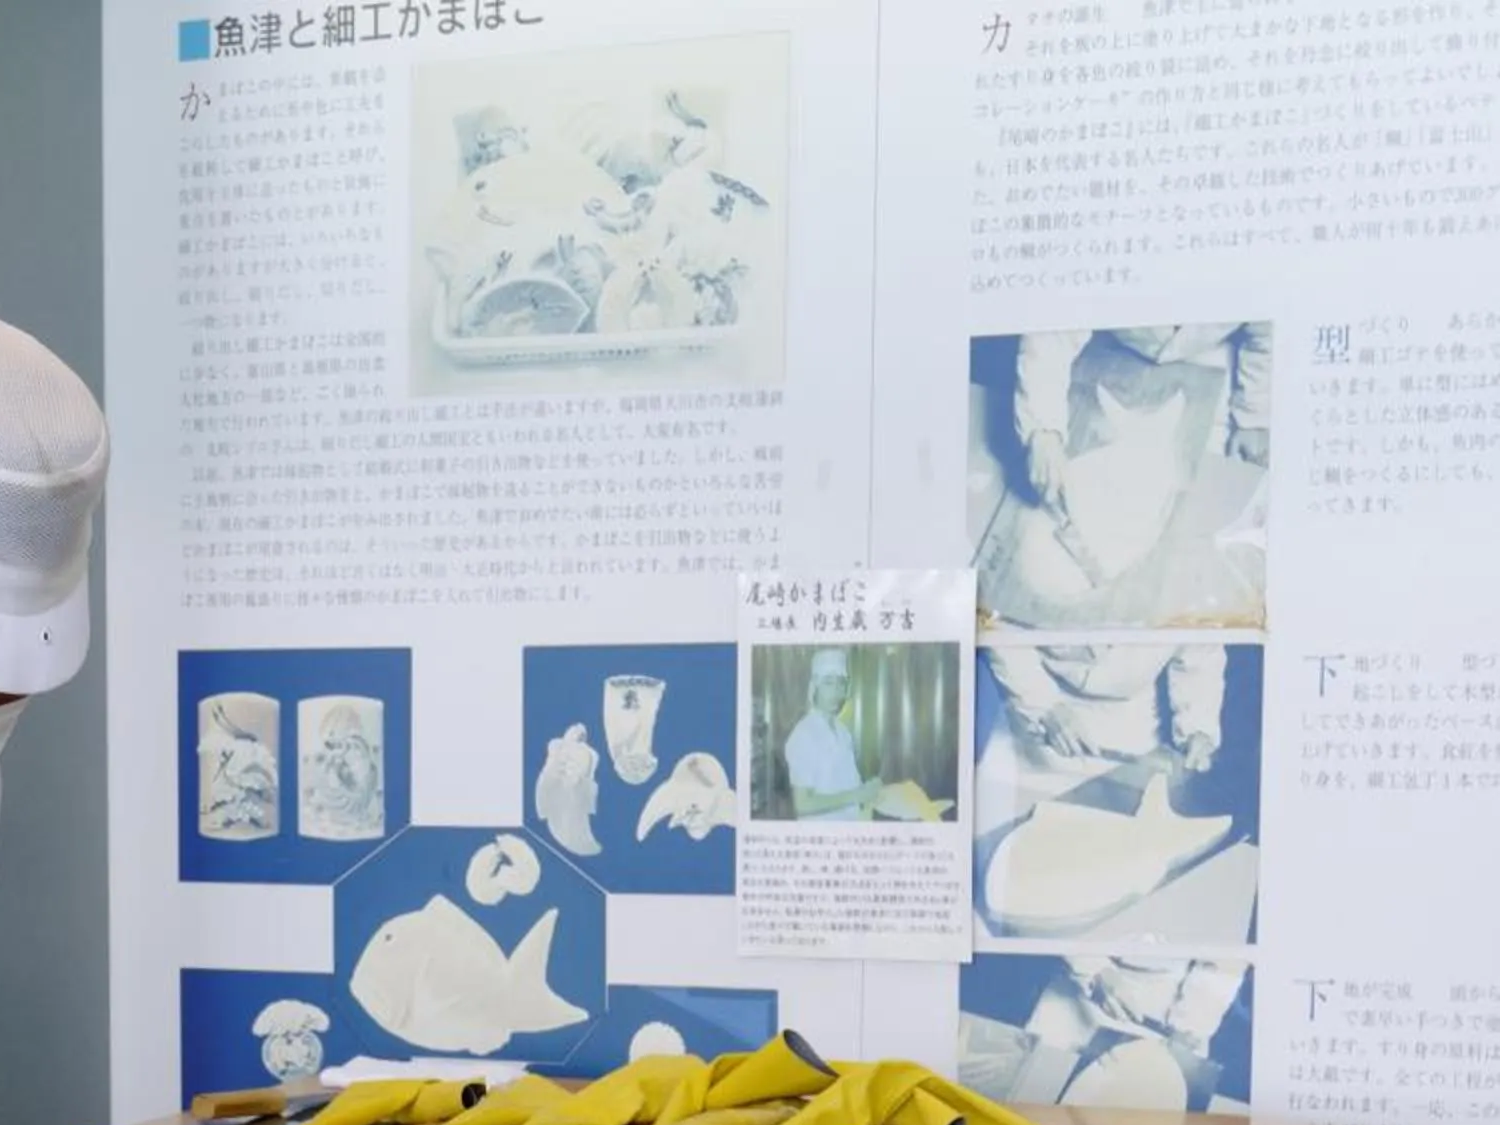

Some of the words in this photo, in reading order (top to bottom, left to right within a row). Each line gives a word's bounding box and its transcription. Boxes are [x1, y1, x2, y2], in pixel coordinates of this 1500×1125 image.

[180, 81, 211, 121] か
[1311, 323, 1350, 365] 型
[1302, 654, 1345, 697] 下
[1293, 979, 1335, 1021] 下
